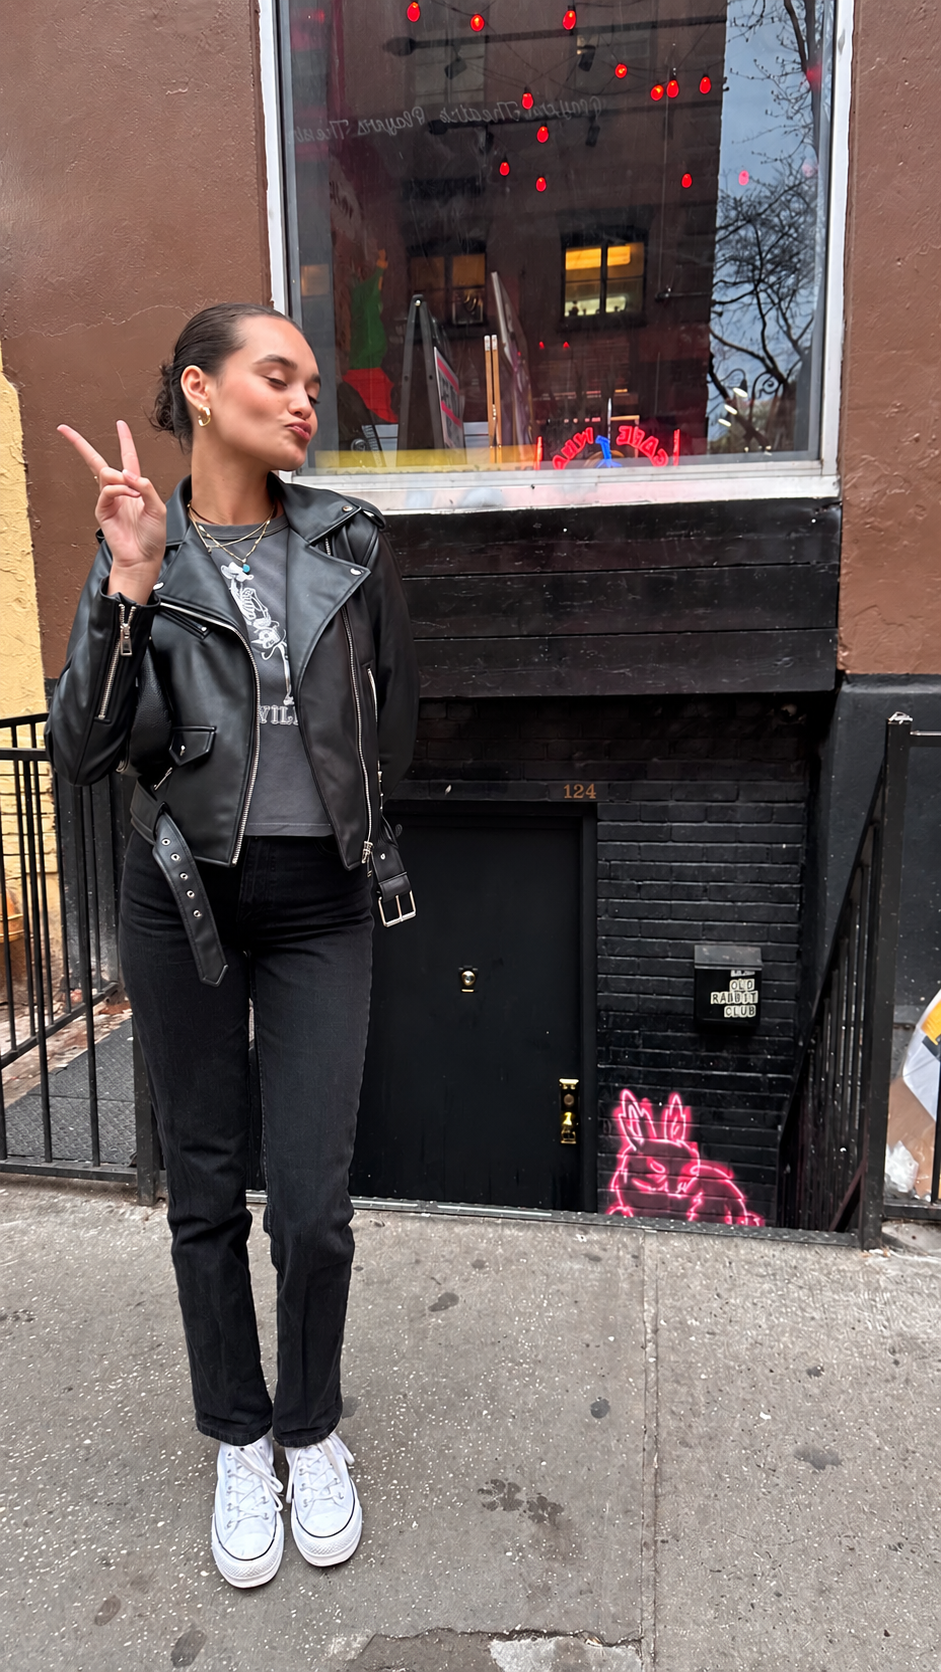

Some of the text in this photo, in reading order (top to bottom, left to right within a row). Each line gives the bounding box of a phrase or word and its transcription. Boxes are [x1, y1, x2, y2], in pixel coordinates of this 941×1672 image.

[563, 783, 597, 799] 124
[730, 980, 754, 991] OLD
[711, 991, 757, 1003] RABBIT
[725, 1005, 755, 1016] CLUB
